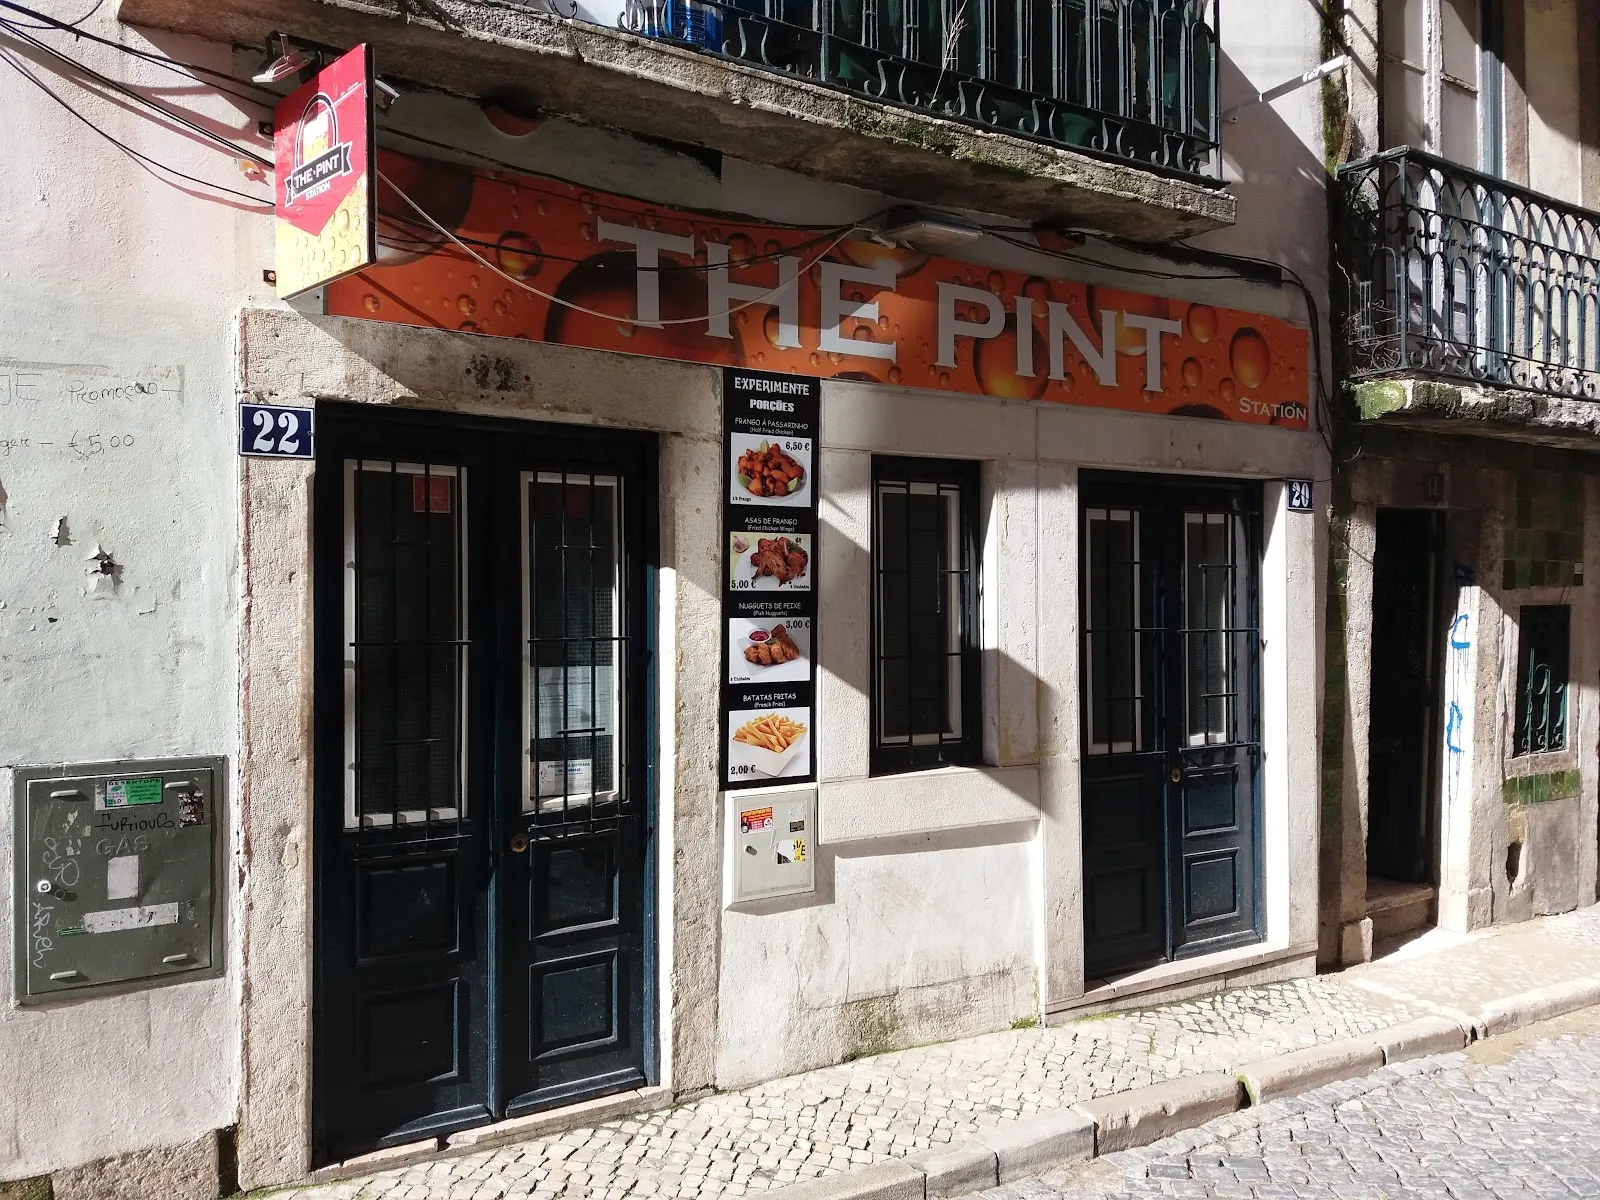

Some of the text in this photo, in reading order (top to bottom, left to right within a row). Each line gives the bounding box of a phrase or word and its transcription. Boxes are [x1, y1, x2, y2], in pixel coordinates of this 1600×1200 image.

[294, 154, 341, 189] THE PINT
[305, 180, 331, 201] STATION
[597, 215, 1183, 393] THE PINT
[734, 376, 810, 396] EXPERIMENTE
[749, 398, 795, 413] PORÇÕES
[734, 416, 809, 430] FRANGO À PASSARINHO
[252, 409, 300, 454] 22
[785, 441, 810, 451] 6,50 €
[1291, 481, 1310, 507] 20
[744, 517, 798, 526] ASAS DE FRANGO
[731, 580, 757, 590] 5,00 €
[738, 602, 802, 610] NUGGUETS DE PEIXE
[785, 619, 810, 629] 3,00 €
[742, 692, 797, 702] BATATAS FRITAS
[730, 764, 756, 776] 2,00 €
[108, 777, 161, 787] DESENTOPE
